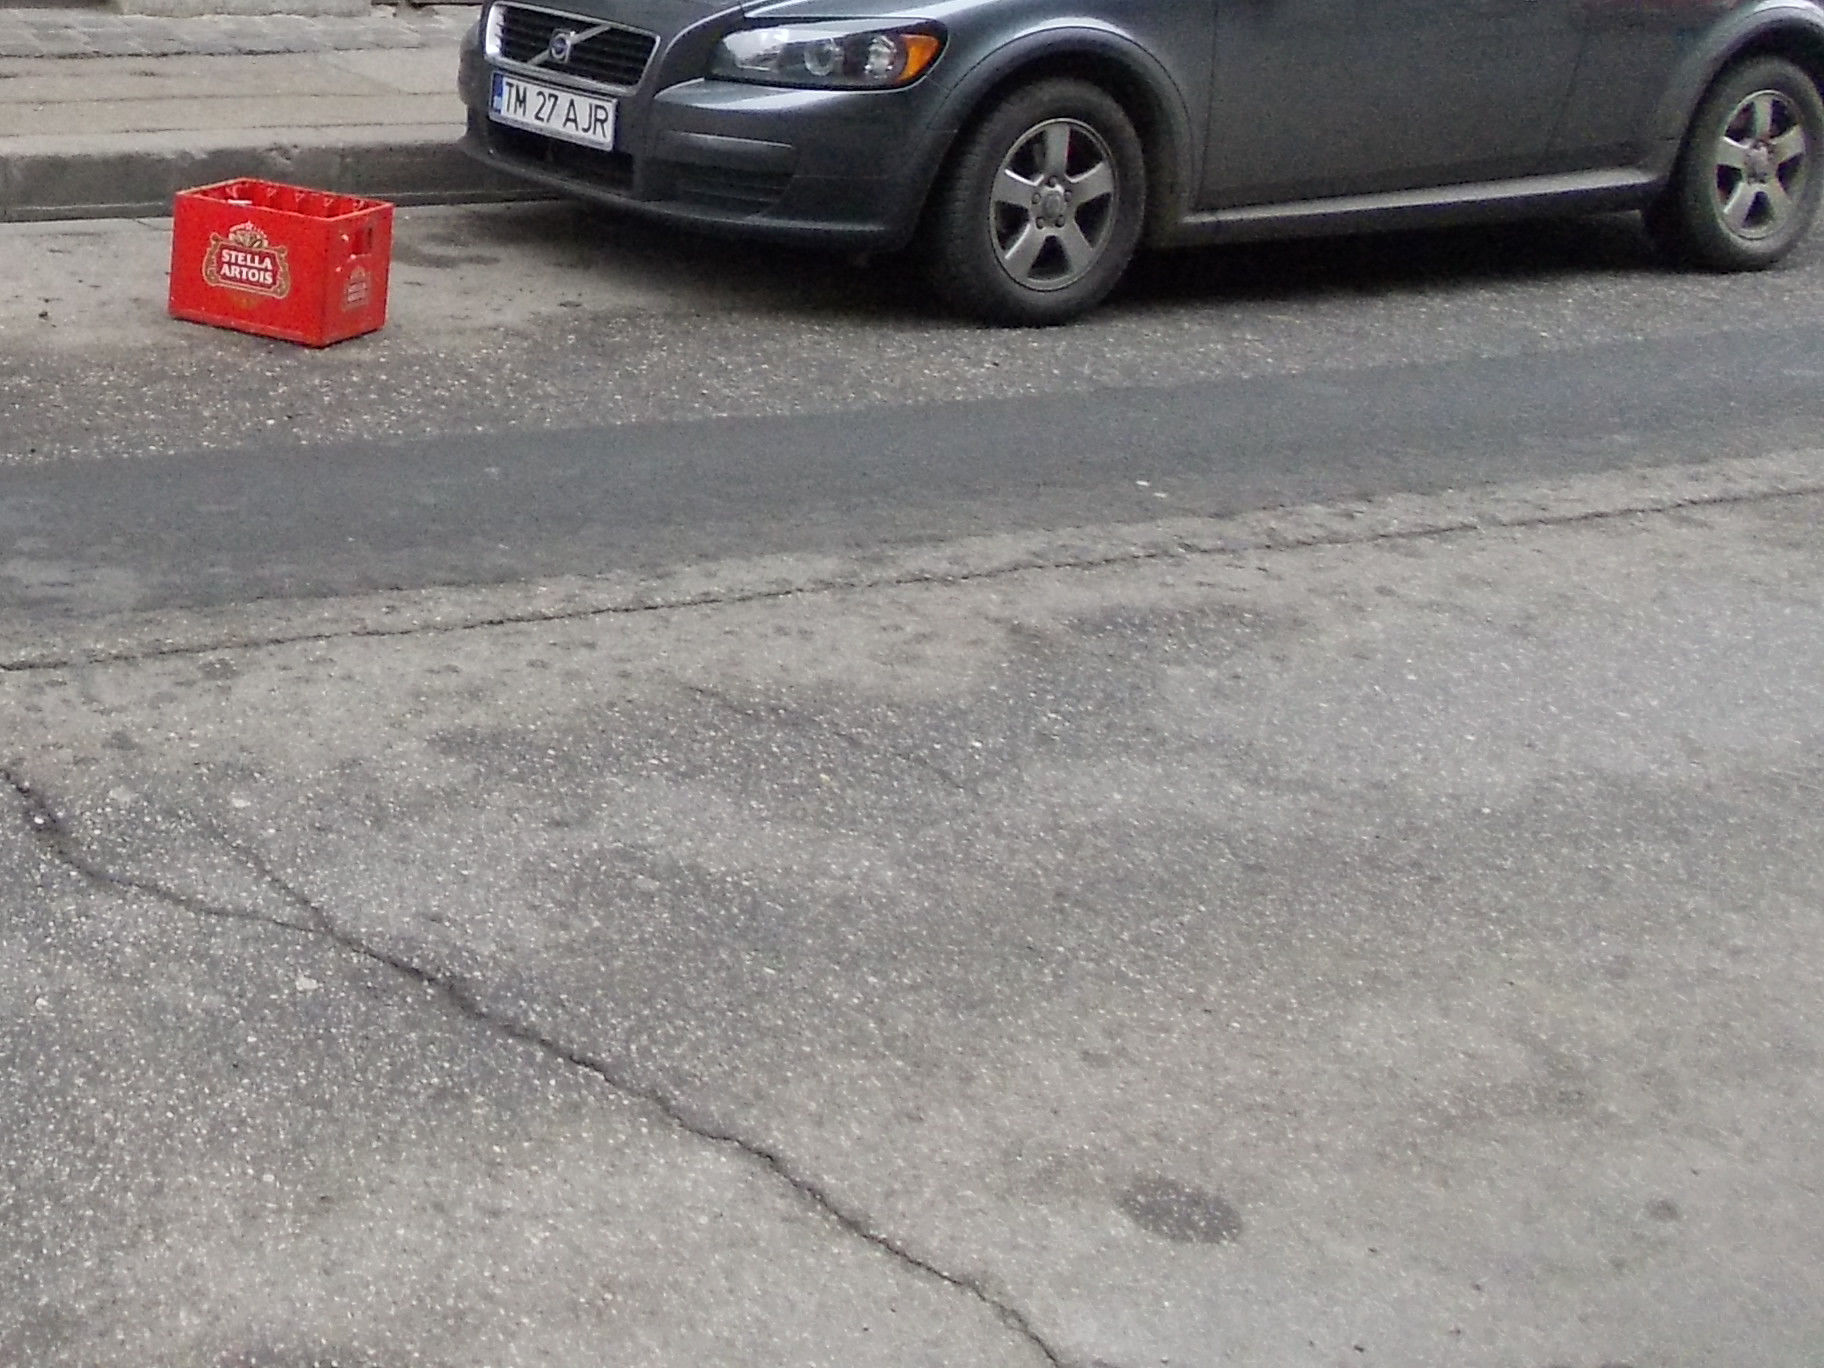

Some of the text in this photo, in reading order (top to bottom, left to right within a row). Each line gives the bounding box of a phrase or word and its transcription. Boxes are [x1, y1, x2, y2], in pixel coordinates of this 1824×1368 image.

[504, 81, 609, 138] TM 27 AJR
[221, 248, 273, 270] STELLA
[220, 263, 273, 285] ARTOIS
